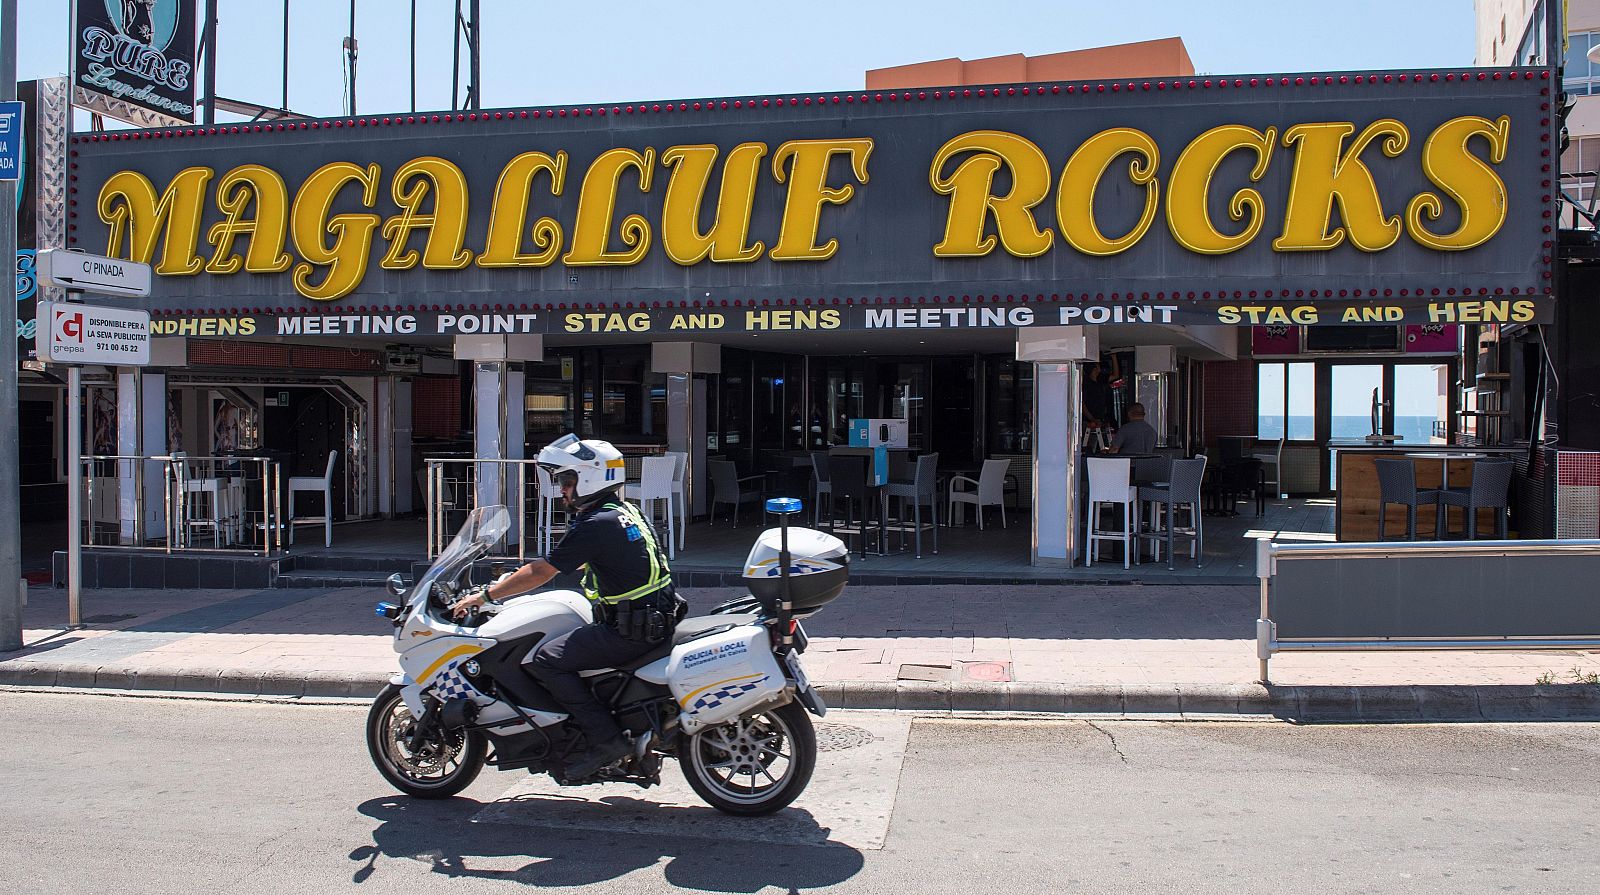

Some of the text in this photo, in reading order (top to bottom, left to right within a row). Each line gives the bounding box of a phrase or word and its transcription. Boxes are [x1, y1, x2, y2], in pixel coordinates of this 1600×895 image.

[82, 26, 190, 91] PURE
[81, 63, 194, 114] Lapdance
[97, 115, 1511, 301] MAGALLUF ROCKS
[94, 262, 124, 277] PINADA
[89, 318, 127, 329] DISPONIBLE
[127, 321, 139, 330] PER
[278, 314, 417, 335] MEETING
[438, 313, 537, 333] POINT
[564, 312, 652, 332] STAG
[669, 313, 726, 330] AND
[745, 309, 841, 331] HENS
[865, 306, 1034, 328] MEETING
[1059, 305, 1178, 325] POINT
[1218, 304, 1320, 325] STAG
[1341, 305, 1405, 323] AND
[1428, 299, 1536, 323] HENS
[87, 329, 147, 342] LA SEVA PUBLICITAT
[53, 344, 85, 354] grepsa
[96, 342, 139, 353] 971 00 45 22
[683, 640, 747, 664] POLICIA LOCAL
